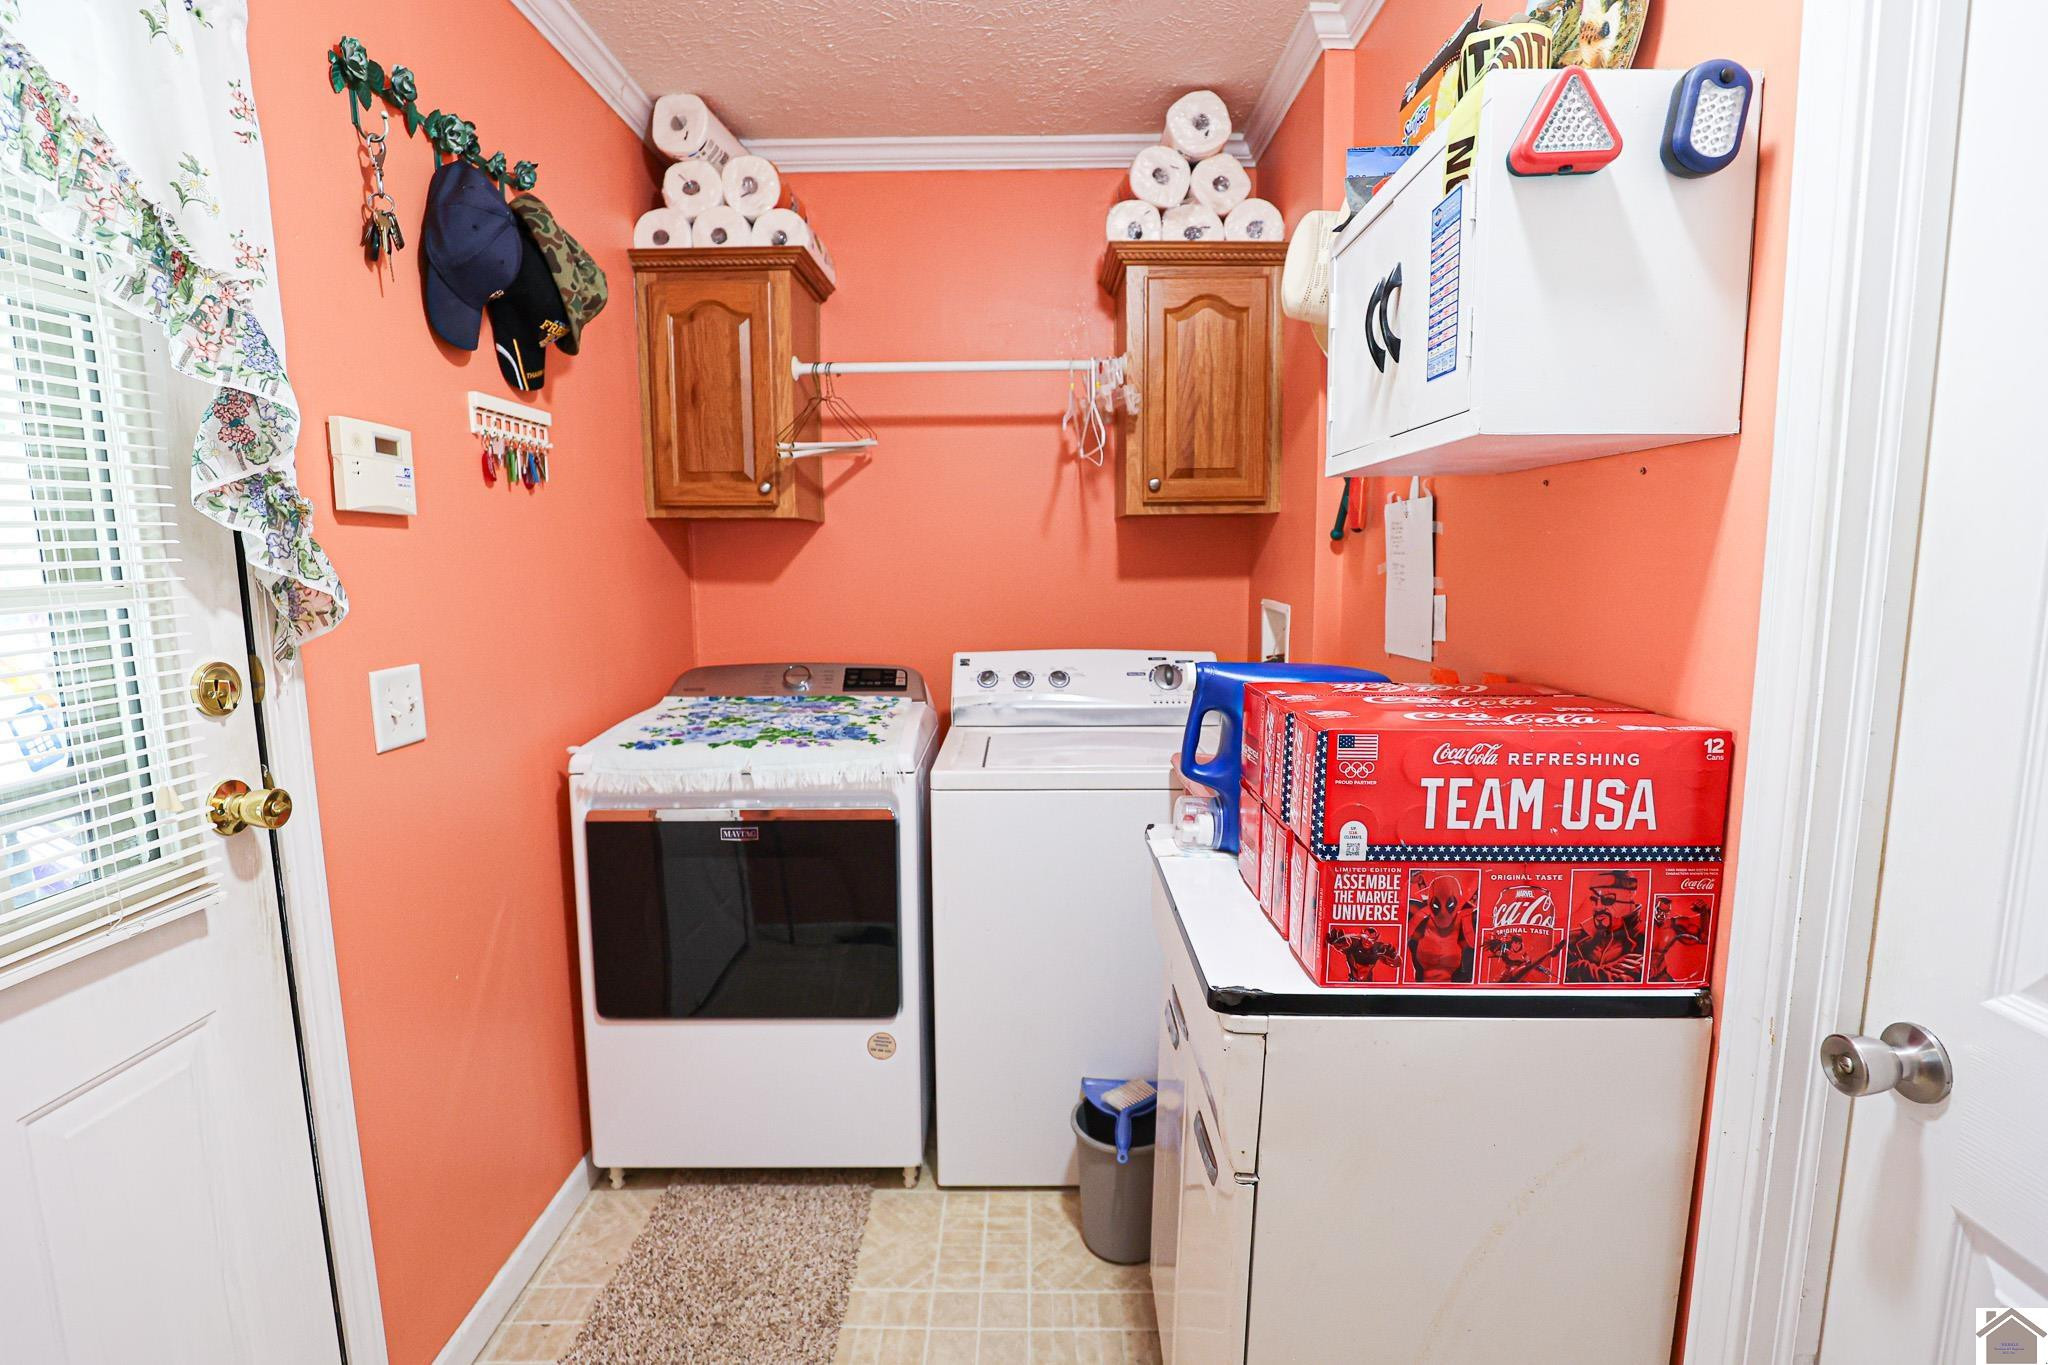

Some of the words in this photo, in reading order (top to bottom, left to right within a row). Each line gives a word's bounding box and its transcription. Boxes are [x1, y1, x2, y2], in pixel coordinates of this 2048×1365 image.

[1403, 711, 1601, 725] Coca-Cola
[1703, 738, 1724, 753] 12
[1433, 742, 1503, 765] Coca-Cola
[1508, 753, 1640, 766] REFRESHING
[1420, 778, 1545, 830] TEAM
[1561, 778, 1657, 830] USA
[722, 830, 757, 838] MAYTAG
[1334, 874, 1401, 890] ASSEMBLE
[1680, 878, 1715, 890] Coca-Cola
[1334, 890, 1354, 904] THE
[1356, 890, 1400, 904] MARVEL
[1516, 890, 1534, 898] MARVEL
[1332, 904, 1399, 921] UNIVERSE
[1529, 928, 1550, 936] TASTE
